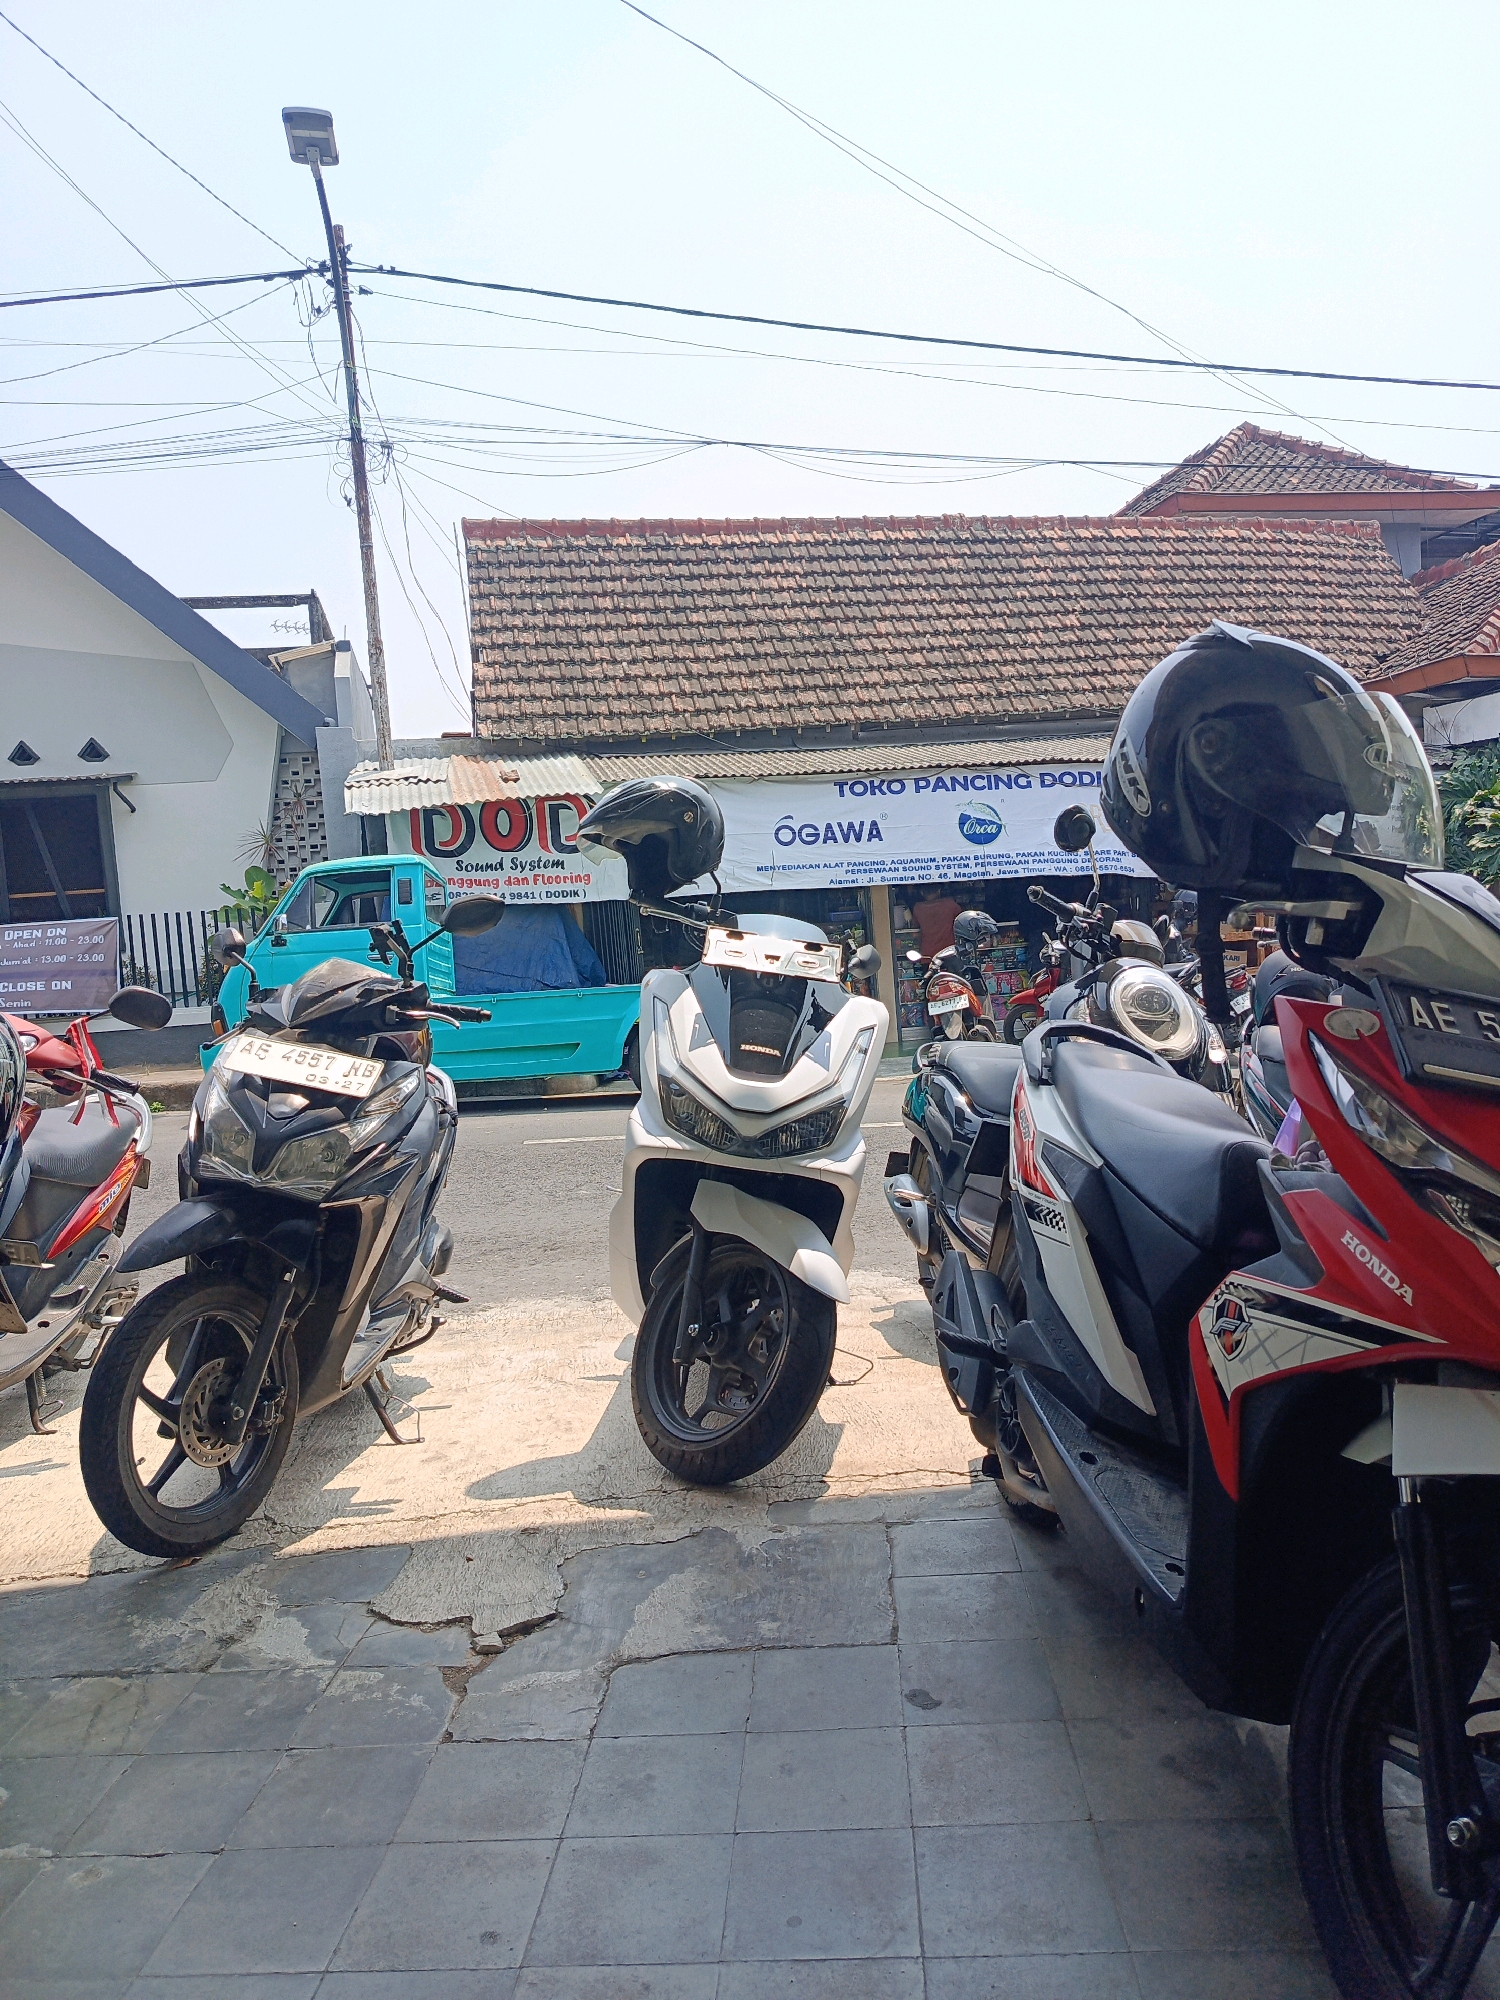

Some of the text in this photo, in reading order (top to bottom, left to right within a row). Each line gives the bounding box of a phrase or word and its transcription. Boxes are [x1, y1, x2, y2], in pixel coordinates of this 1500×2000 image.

[834, 778, 907, 798] TOKO
[913, 773, 1033, 794] PANCING
[1039, 771, 1102, 788] DODI
[963, 817, 998, 835] Orca
[455, 855, 566, 873] Sound System
[756, 862, 821, 873] MENYEDIAKAN
[822, 861, 845, 870] ALAT
[846, 859, 889, 869] PANCING,
[890, 857, 940, 867] AQUARIUM,
[941, 855, 971, 863] PAKAN
[973, 852, 1014, 862] BURUNG,
[1015, 851, 1045, 859] PAKAN
[845, 866, 900, 875] PERSEWAAN
[902, 865, 932, 873] SOUND
[934, 862, 972, 871] SYSTEM,
[974, 858, 1030, 868] PERSEWAAN
[1032, 857, 1079, 865] PANGGUNG
[503, 874, 530, 887] dan
[533, 872, 592, 885] Flooring
[829, 878, 859, 886] Alamat
[880, 875, 916, 883] Sumatra
[918, 873, 935, 881] NO.
[996, 868, 1019, 876] Jawa
[1021, 866, 1046, 874] Timur
[509, 891, 536, 900] 9841
[545, 889, 581, 898] DODIK
[4, 927, 67, 941] OPEN ON
[12, 940, 36, 949] Ahad
[44, 937, 67, 946] 11.00
[77, 935, 105, 944] 23.00
[41, 954, 67, 963] 13.00
[77, 953, 105, 962] 23.00
[0, 980, 72, 993] CLOSE ON
[0, 997, 31, 1008] Senin
[1411, 996, 1461, 1035] AE
[240, 1040, 273, 1060] AE
[281, 1048, 338, 1071] 4557
[740, 1044, 782, 1057] HONDA
[1340, 1229, 1414, 1307] HONDA
[1212, 1317, 1252, 1338] FI
